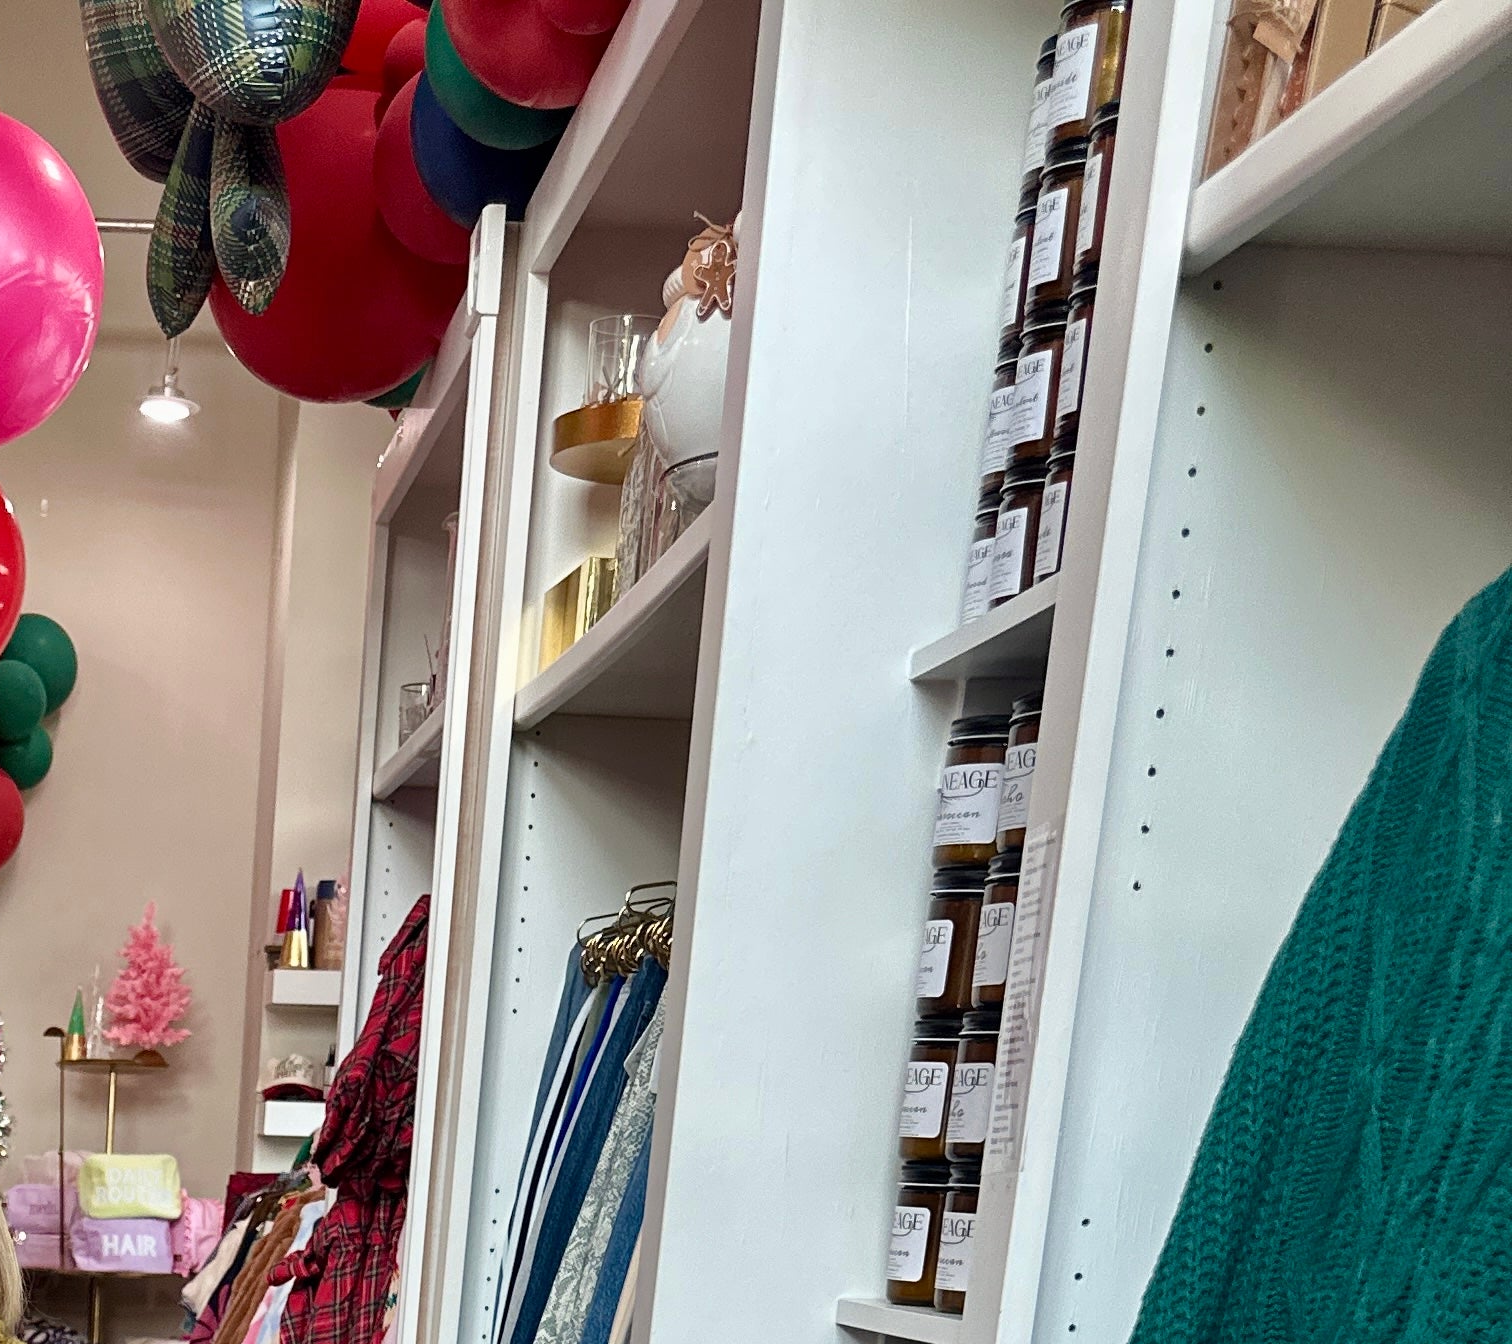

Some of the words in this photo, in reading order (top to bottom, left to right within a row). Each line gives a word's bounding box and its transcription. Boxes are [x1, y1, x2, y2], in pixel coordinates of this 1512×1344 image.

[942, 769, 1000, 791] NEAGE
[907, 1067, 944, 1087] EAGE
[942, 1218, 976, 1239] EAGE
[101, 1233, 157, 1258] HAIR
